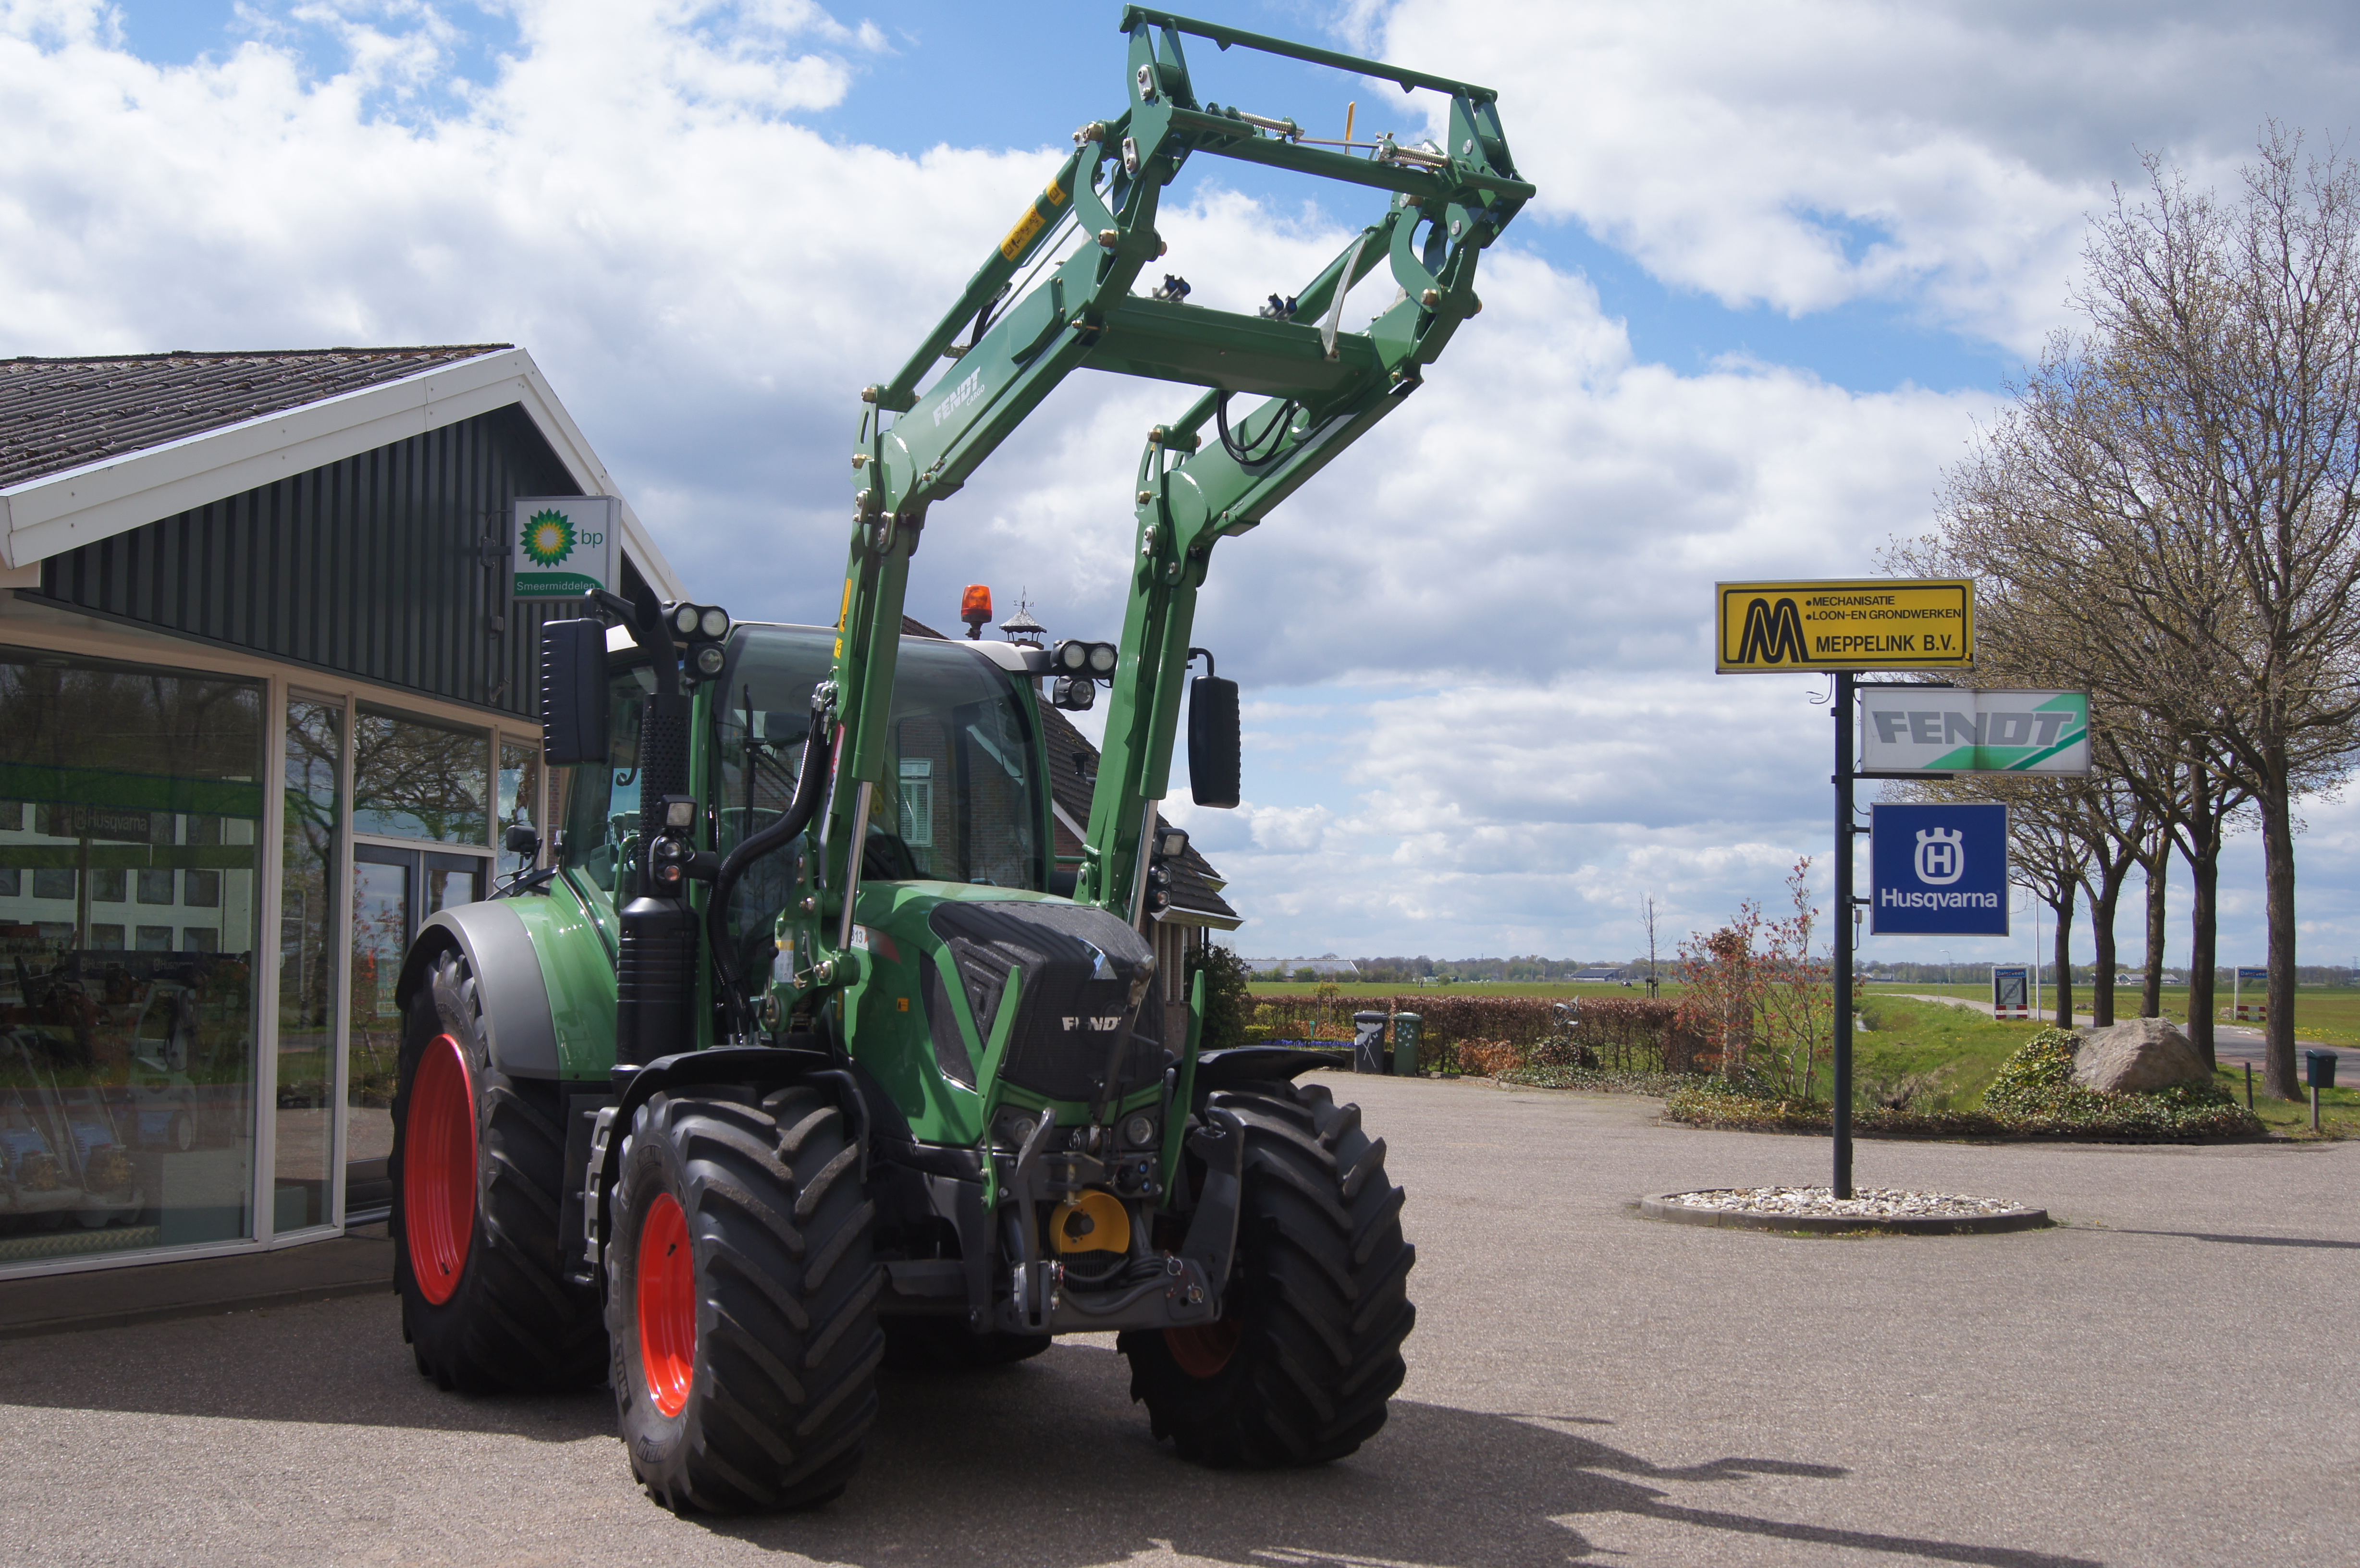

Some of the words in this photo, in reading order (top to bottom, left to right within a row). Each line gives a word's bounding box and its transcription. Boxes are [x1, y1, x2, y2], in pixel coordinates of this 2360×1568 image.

[933, 366, 981, 427] FENDT
[966, 384, 985, 406] CARGO
[581, 529, 603, 549] bp
[517, 581, 595, 591] Smeermiddelen
[1813, 596, 1895, 606] MECHANISATIE
[1813, 610, 1867, 620] LOON-EN
[1869, 609, 1961, 619] GRONDWERKEN
[1816, 635, 1916, 652] MEPPELINK
[1923, 634, 1956, 651] B.V.
[1872, 710, 2074, 747] FENDT
[88, 809, 147, 833] Husqvarna
[1881, 887, 1998, 910] Husqvarna
[1062, 1016, 1122, 1031] FND
